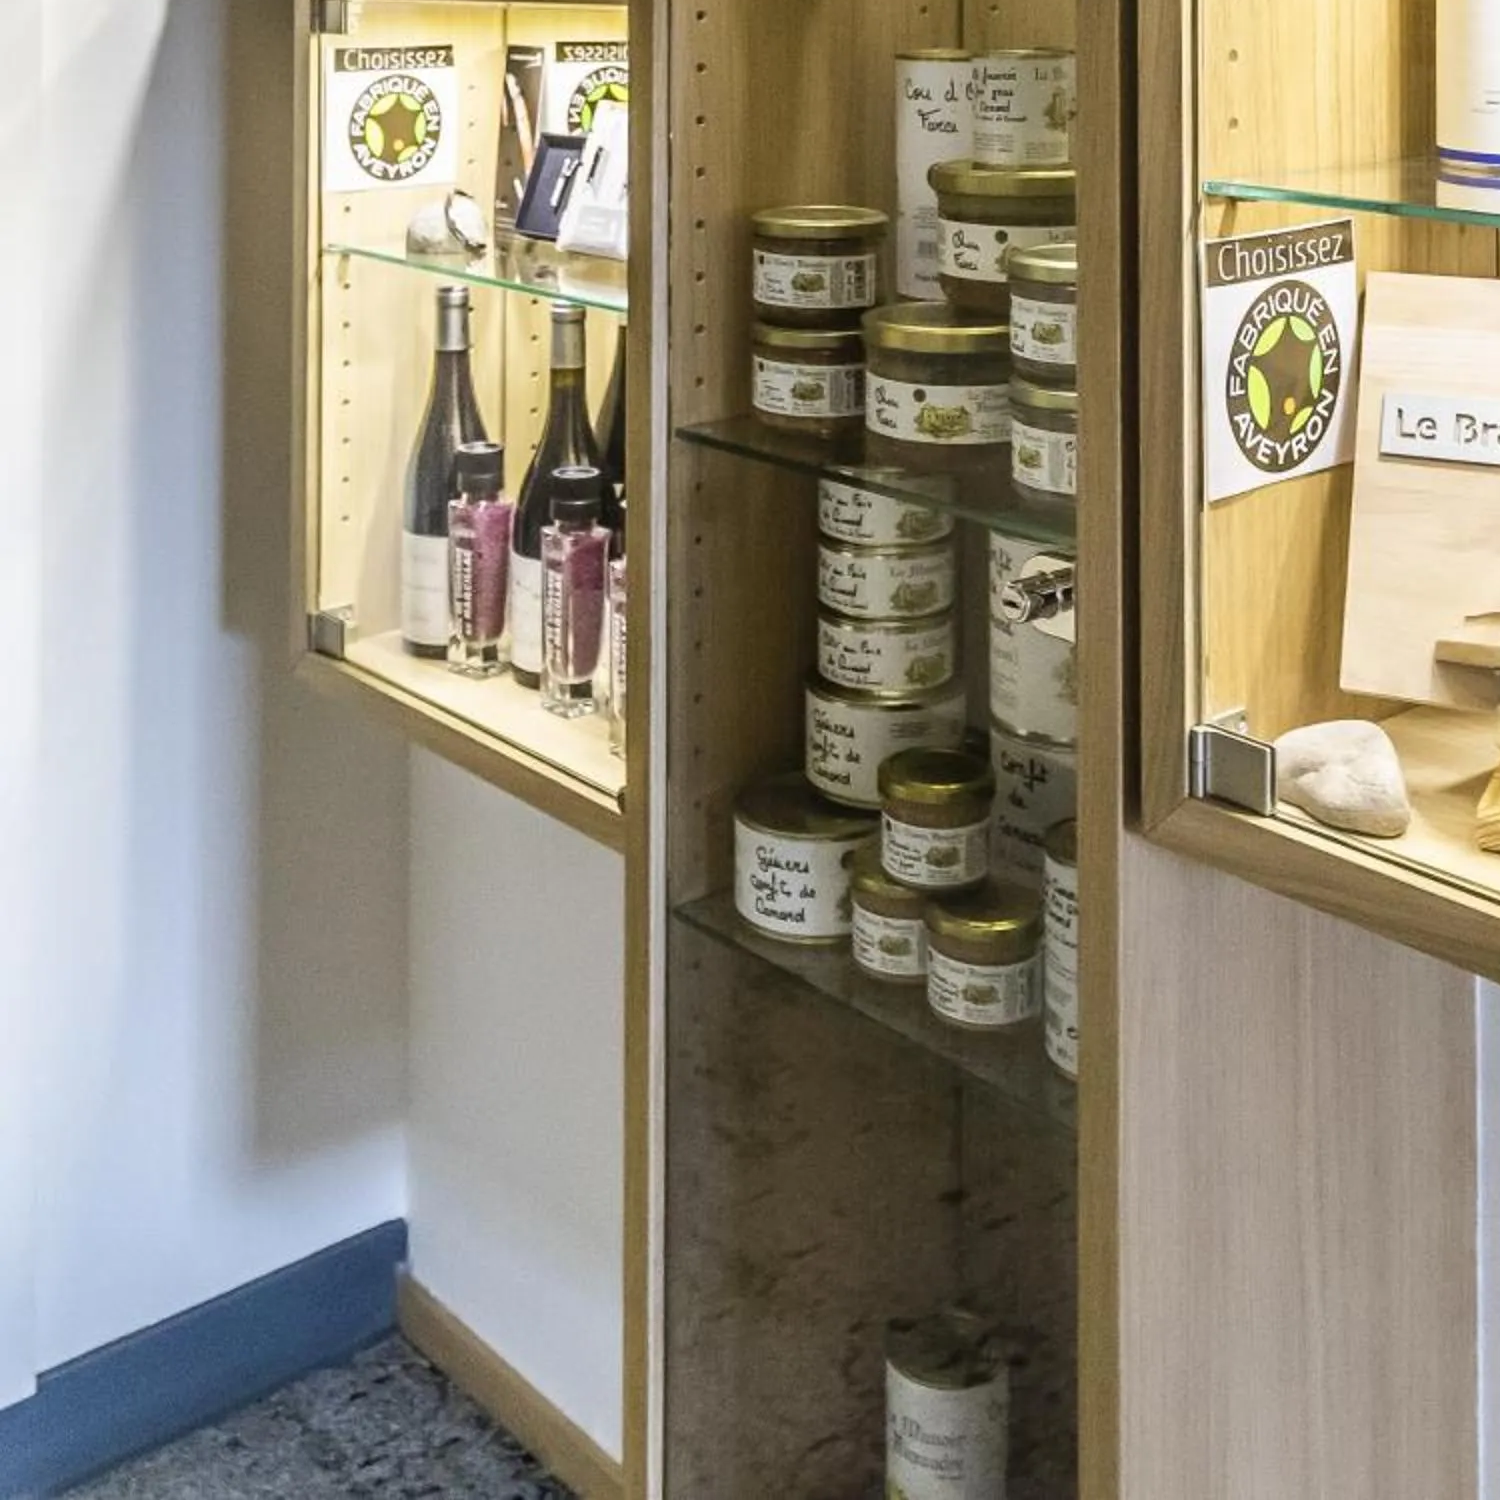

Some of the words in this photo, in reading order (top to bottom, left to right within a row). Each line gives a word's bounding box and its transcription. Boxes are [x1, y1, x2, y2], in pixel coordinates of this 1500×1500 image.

[343, 48, 448, 71] Choisissez
[423, 102, 441, 131] EN
[354, 140, 437, 179] AVEYRON
[1217, 233, 1345, 281] Choisissez
[1318, 323, 1339, 375] EN
[1234, 388, 1335, 465] AVEYRON
[1396, 408, 1438, 440] Le
